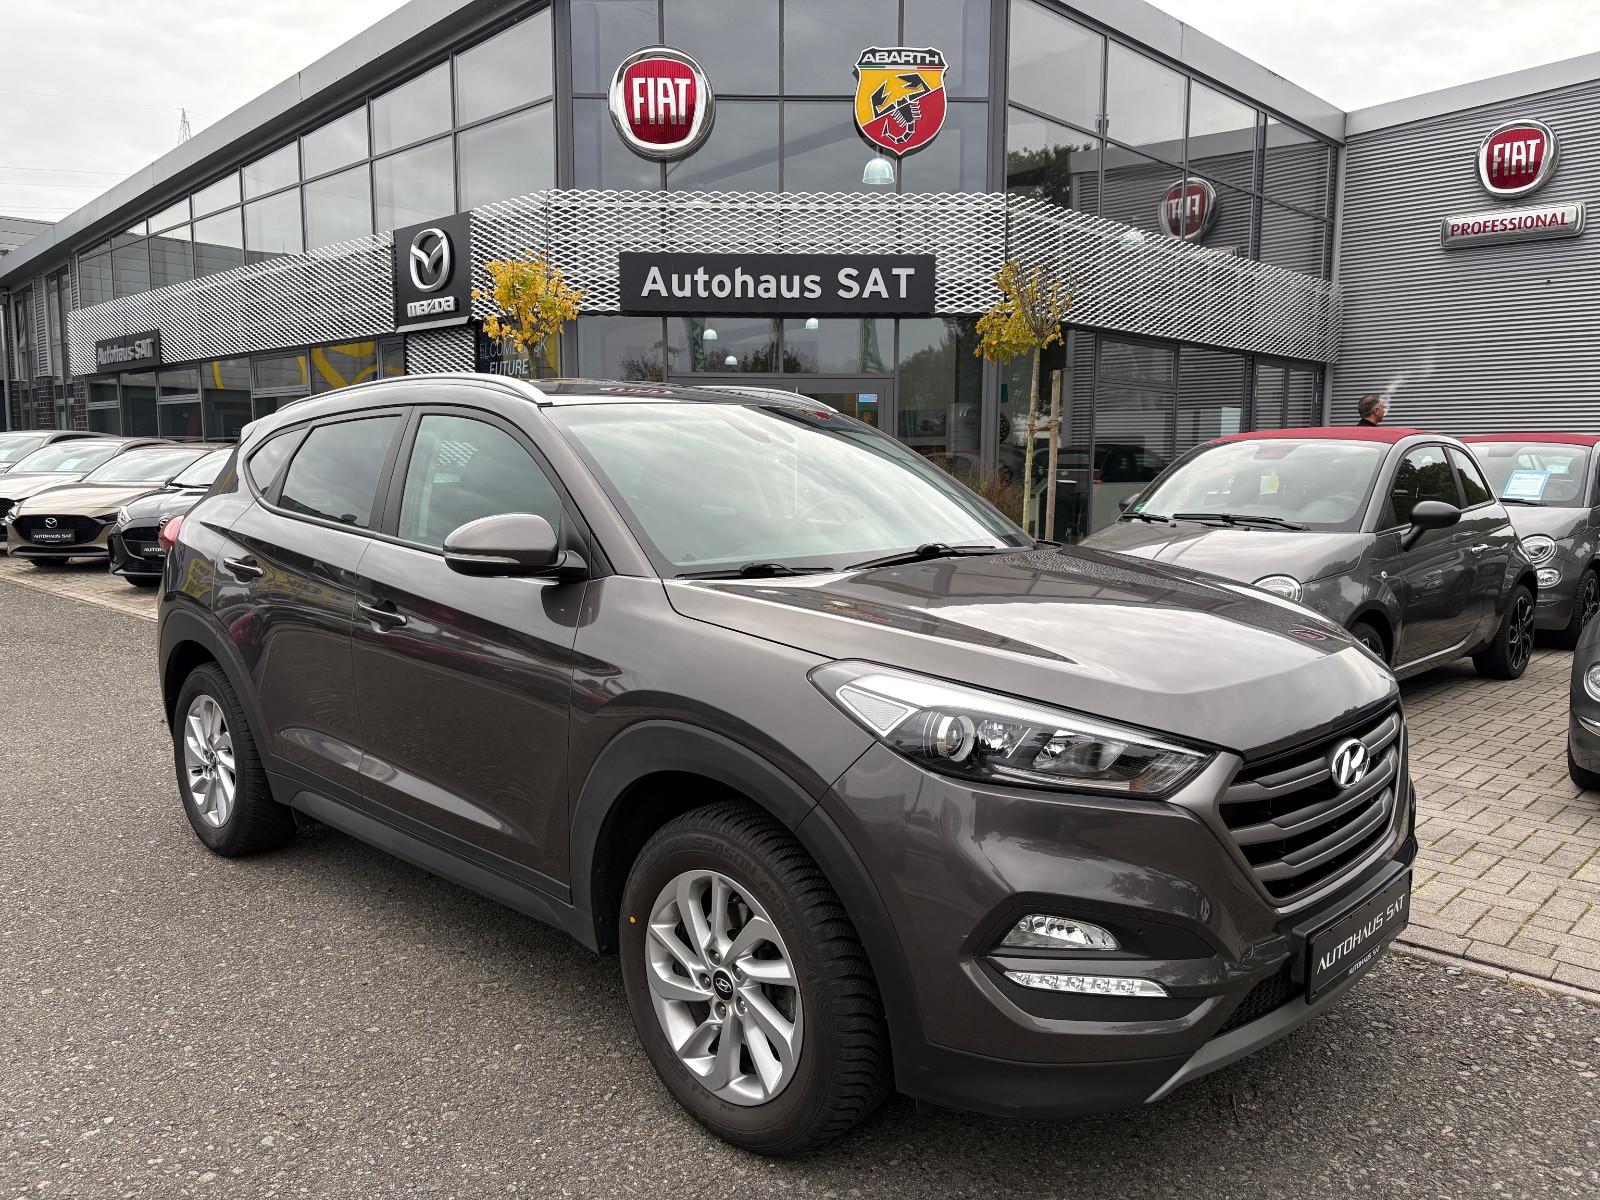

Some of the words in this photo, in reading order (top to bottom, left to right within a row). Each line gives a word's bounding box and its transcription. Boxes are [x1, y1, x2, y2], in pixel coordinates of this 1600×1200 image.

[861, 51, 939, 64] ABARTH
[632, 76, 691, 125] FIAT
[1492, 138, 1541, 178] FIAT
[1450, 211, 1569, 237] PROFESSIONAL
[640, 266, 822, 300] Autohaus
[836, 266, 916, 299] SAT
[97, 344, 135, 366] Autohaus
[134, 337, 155, 360] SAT
[489, 359, 529, 376] FUTURE
[1316, 912, 1384, 975] AUTOHAUS
[1386, 893, 1406, 921] SAT
